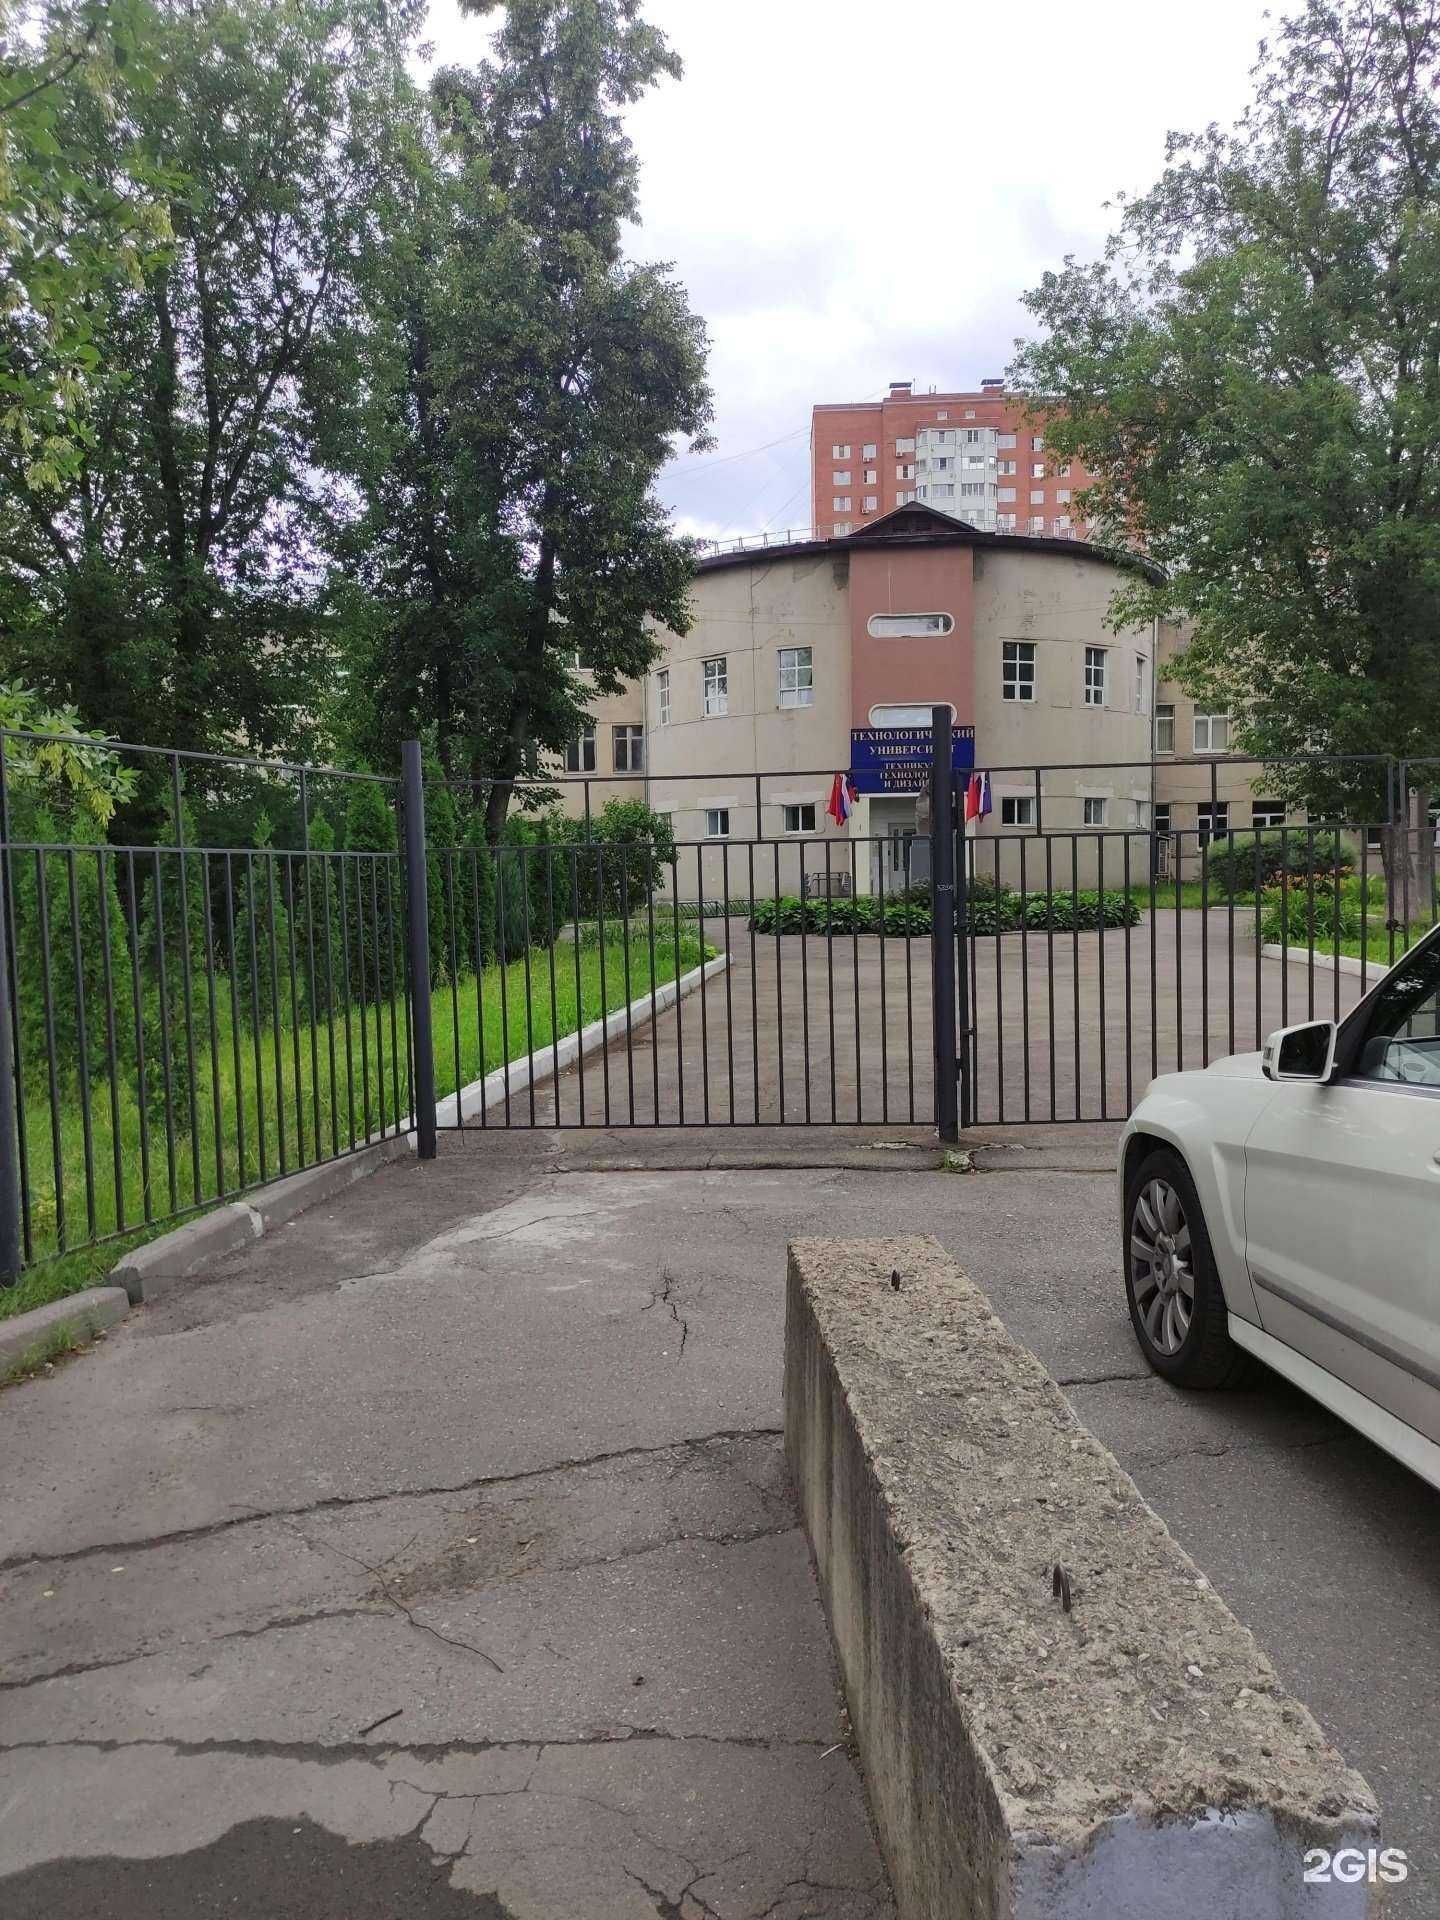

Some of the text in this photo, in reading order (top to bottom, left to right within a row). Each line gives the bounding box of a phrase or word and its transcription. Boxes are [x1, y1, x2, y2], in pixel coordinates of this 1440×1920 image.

[852, 727, 974, 741] ТЕХНОЛОГИЧКИЙ
[869, 744, 955, 755] УНИВЕРСИТ
[885, 762, 934, 770] ТЕХНИКУ
[880, 771, 929, 780] ТЕХНОЛОГ
[884, 780, 929, 788] И ДИЗАЙ
